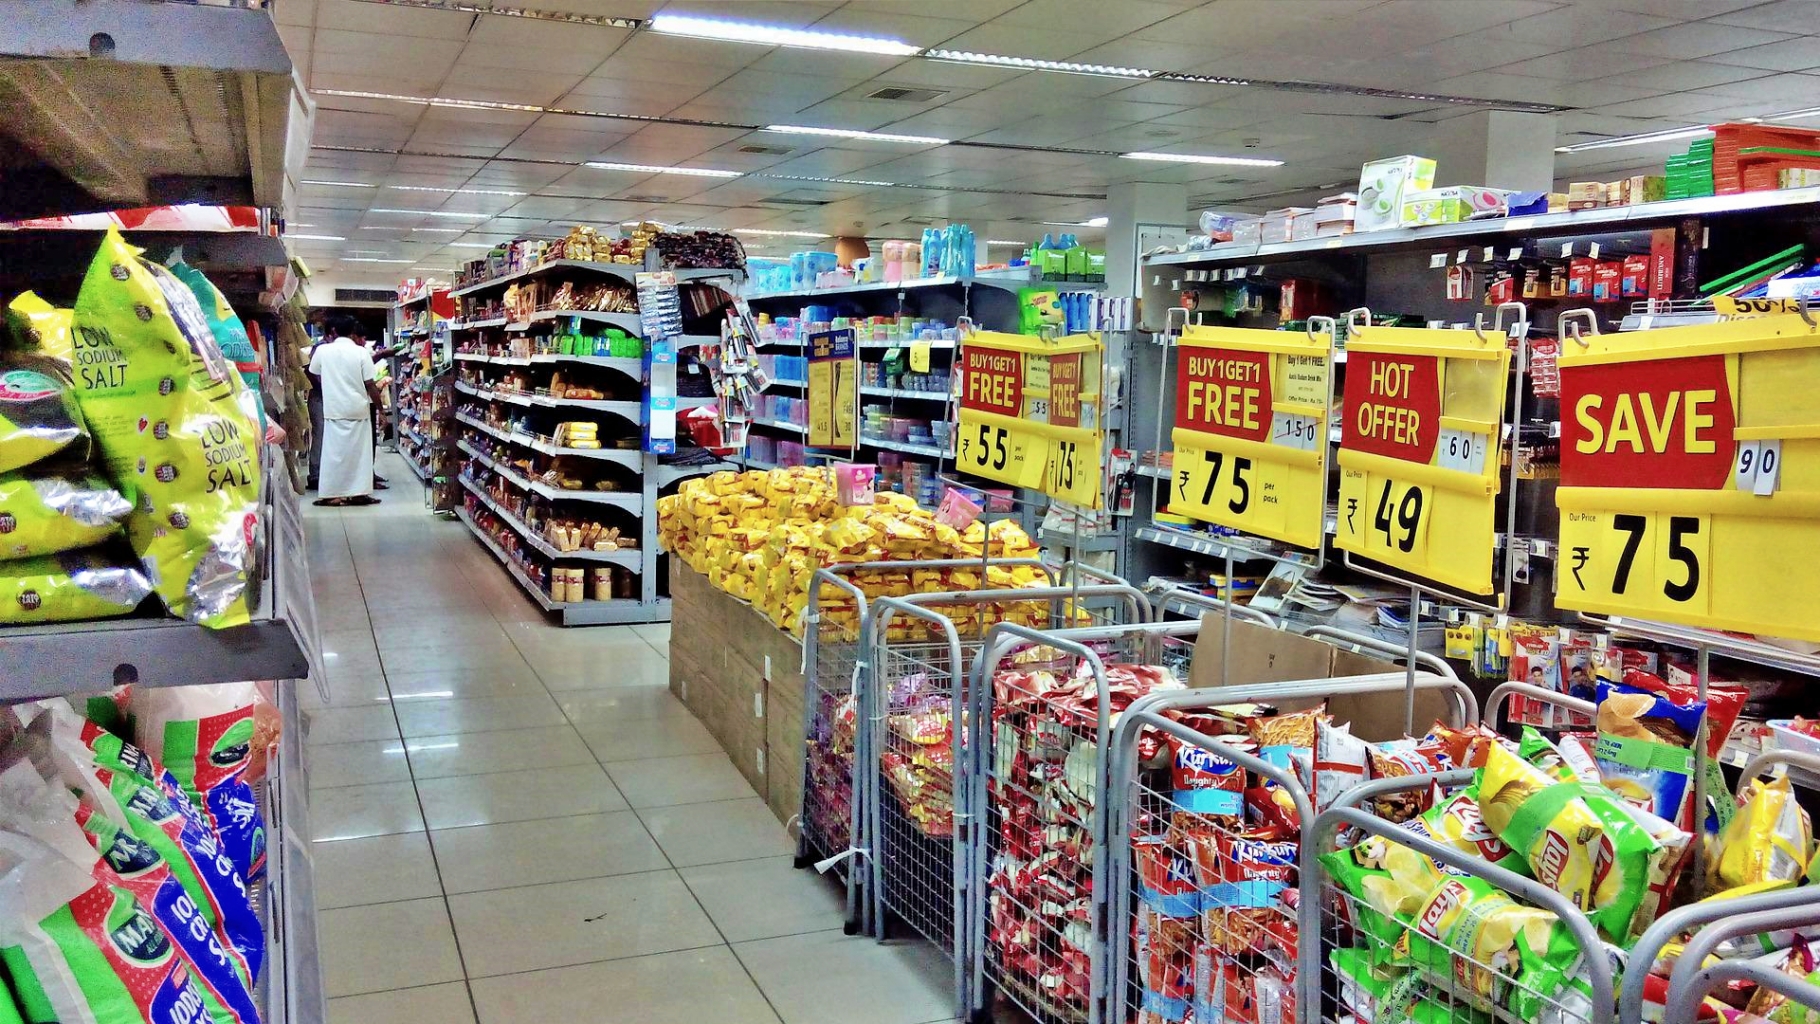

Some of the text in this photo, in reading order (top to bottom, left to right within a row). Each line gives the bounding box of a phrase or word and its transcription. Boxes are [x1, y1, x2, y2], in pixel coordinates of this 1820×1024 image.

[70, 326, 114, 349] LOW
[76, 348, 127, 366] SODIUM
[81, 364, 128, 390] SALT
[969, 371, 1015, 408] FREE
[1370, 360, 1415, 400] HOT
[1052, 383, 1077, 418] FREE
[1187, 382, 1260, 431] FREE
[200, 419, 240, 449] LOW
[1286, 419, 1314, 441] 150
[1357, 401, 1420, 447] OFFER
[1575, 388, 1717, 455] SAVE
[976, 424, 1008, 471] 55
[1059, 440, 1076, 490] 75
[1450, 436, 1470, 460] 60
[1740, 449, 1775, 474] 90
[206, 459, 251, 494] SALT
[1202, 450, 1251, 514] 75
[1264, 483, 1275, 491] per
[1263, 495, 1278, 504] pack
[1375, 479, 1423, 553] 49
[1569, 512, 1596, 523] Our Price
[1612, 514, 1700, 602] 75
